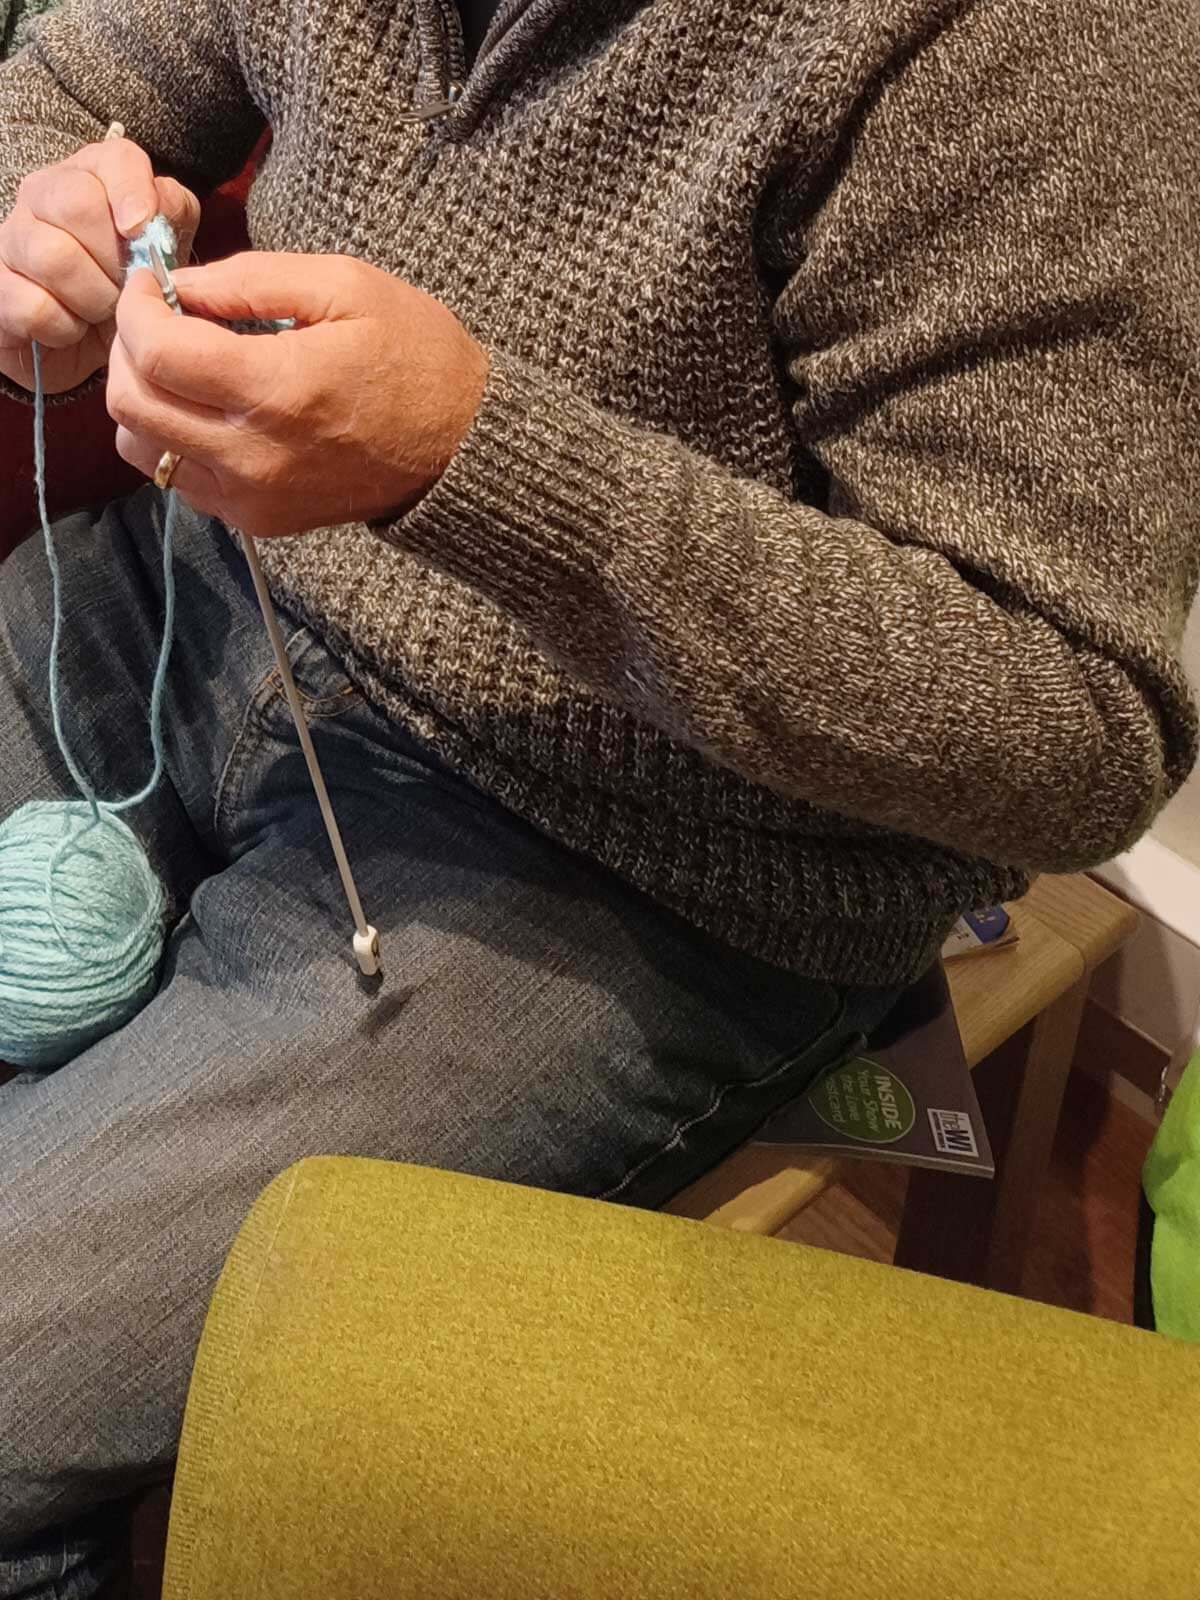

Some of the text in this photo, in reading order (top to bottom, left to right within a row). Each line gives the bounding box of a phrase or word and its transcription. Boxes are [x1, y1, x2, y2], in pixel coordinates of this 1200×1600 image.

[840, 1074, 860, 1121] the Love
[857, 1070, 880, 1134] Your Show
[874, 1075, 903, 1130] INSIDE
